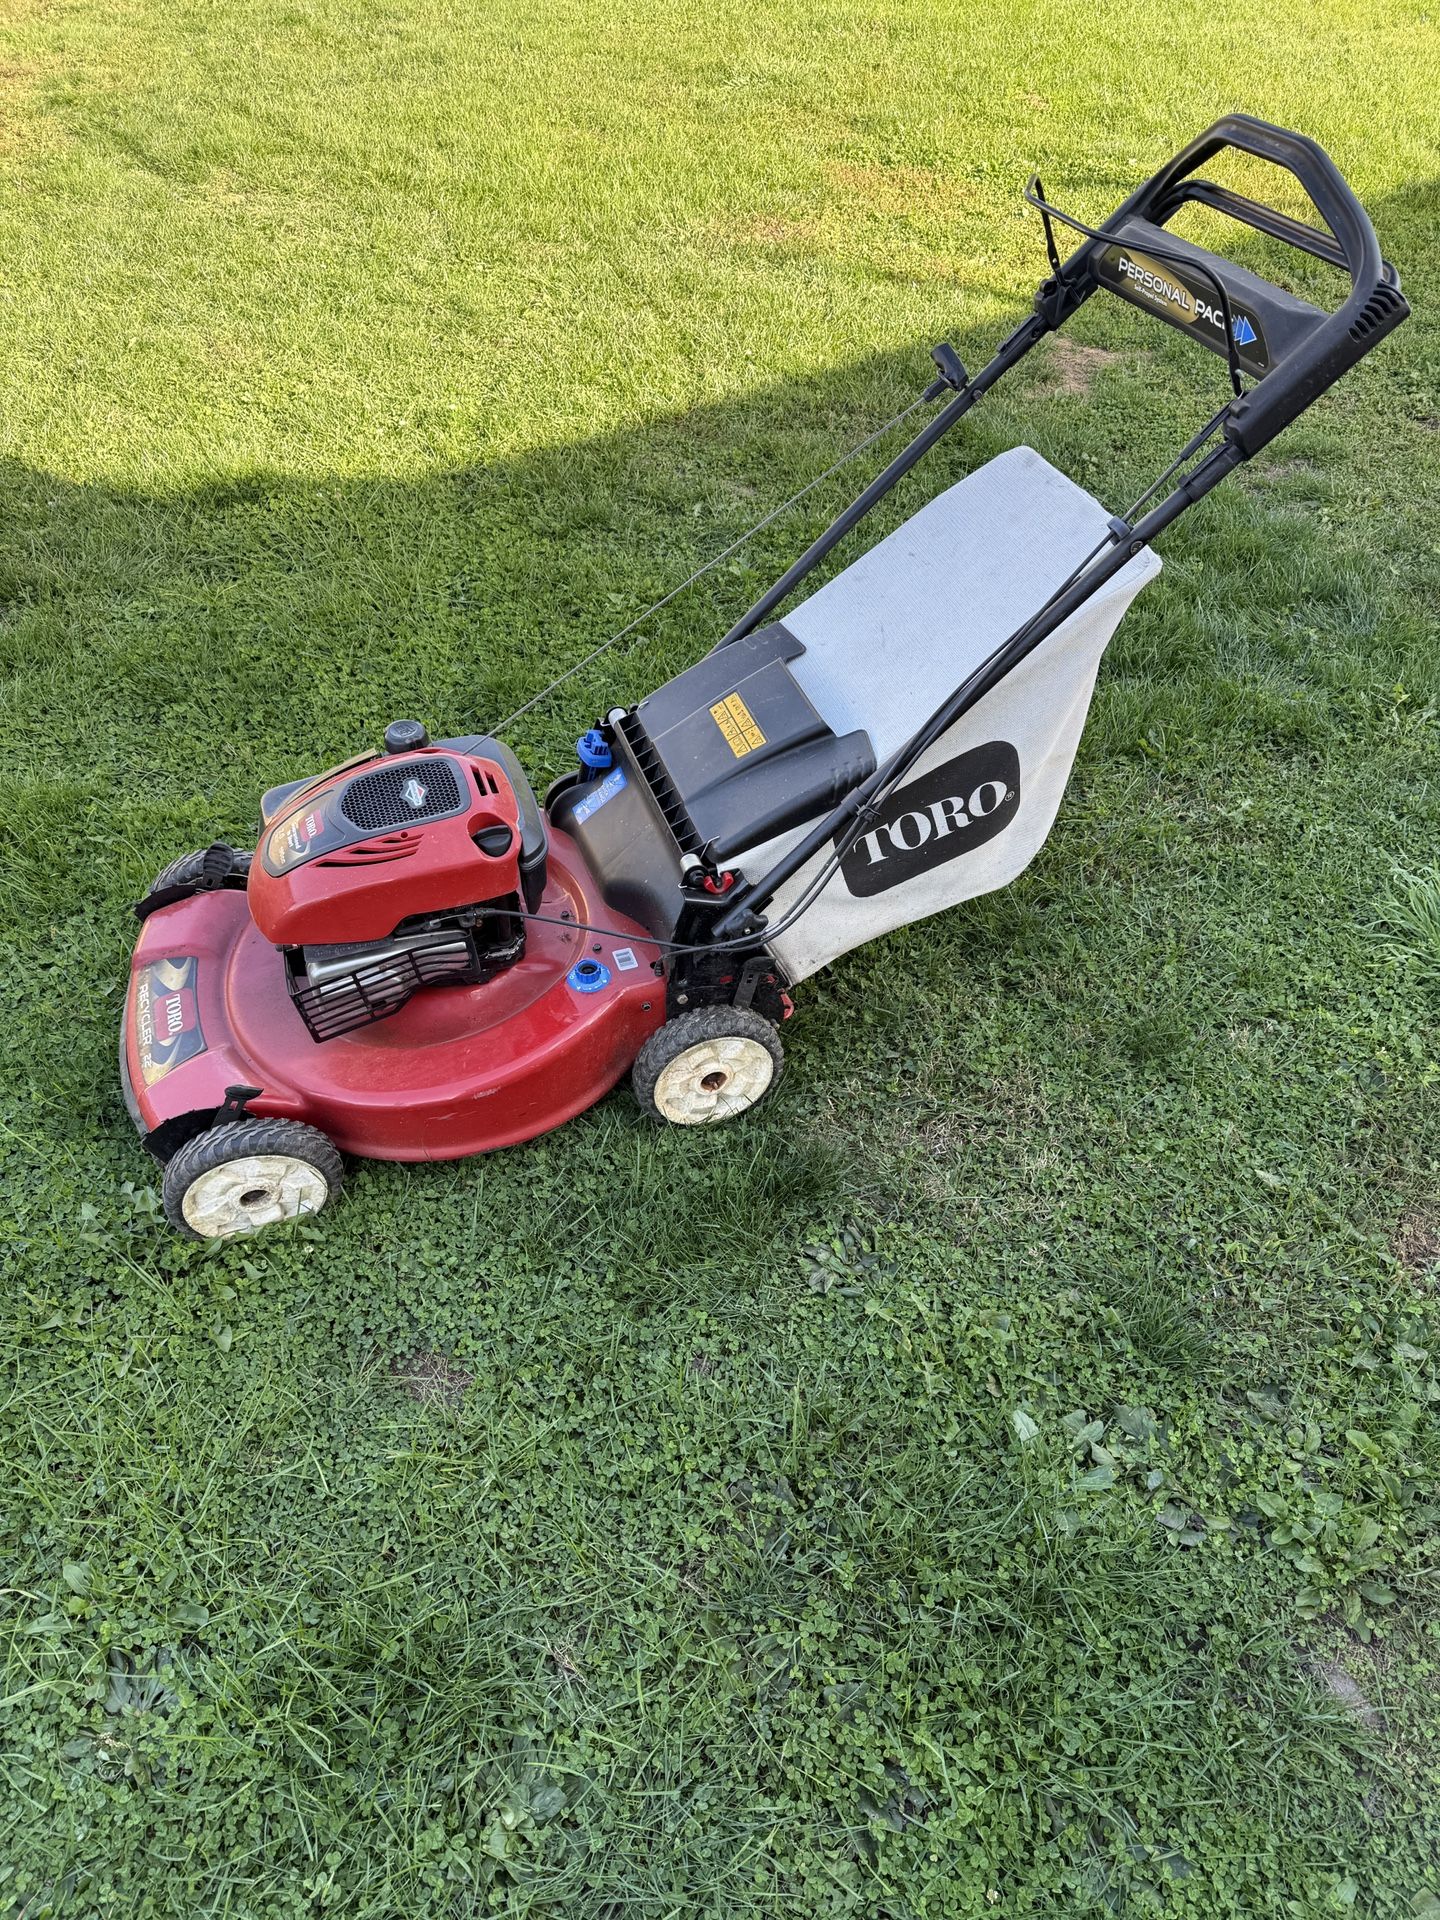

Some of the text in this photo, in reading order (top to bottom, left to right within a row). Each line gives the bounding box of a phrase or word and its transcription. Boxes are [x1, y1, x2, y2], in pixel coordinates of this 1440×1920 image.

[1118, 257, 1233, 331] PERSONAL PAC
[305, 814, 318, 838] TORO
[853, 781, 1008, 866] TORO
[139, 983, 153, 1069] RECYCLER 22
[166, 993, 183, 1033] TORO
